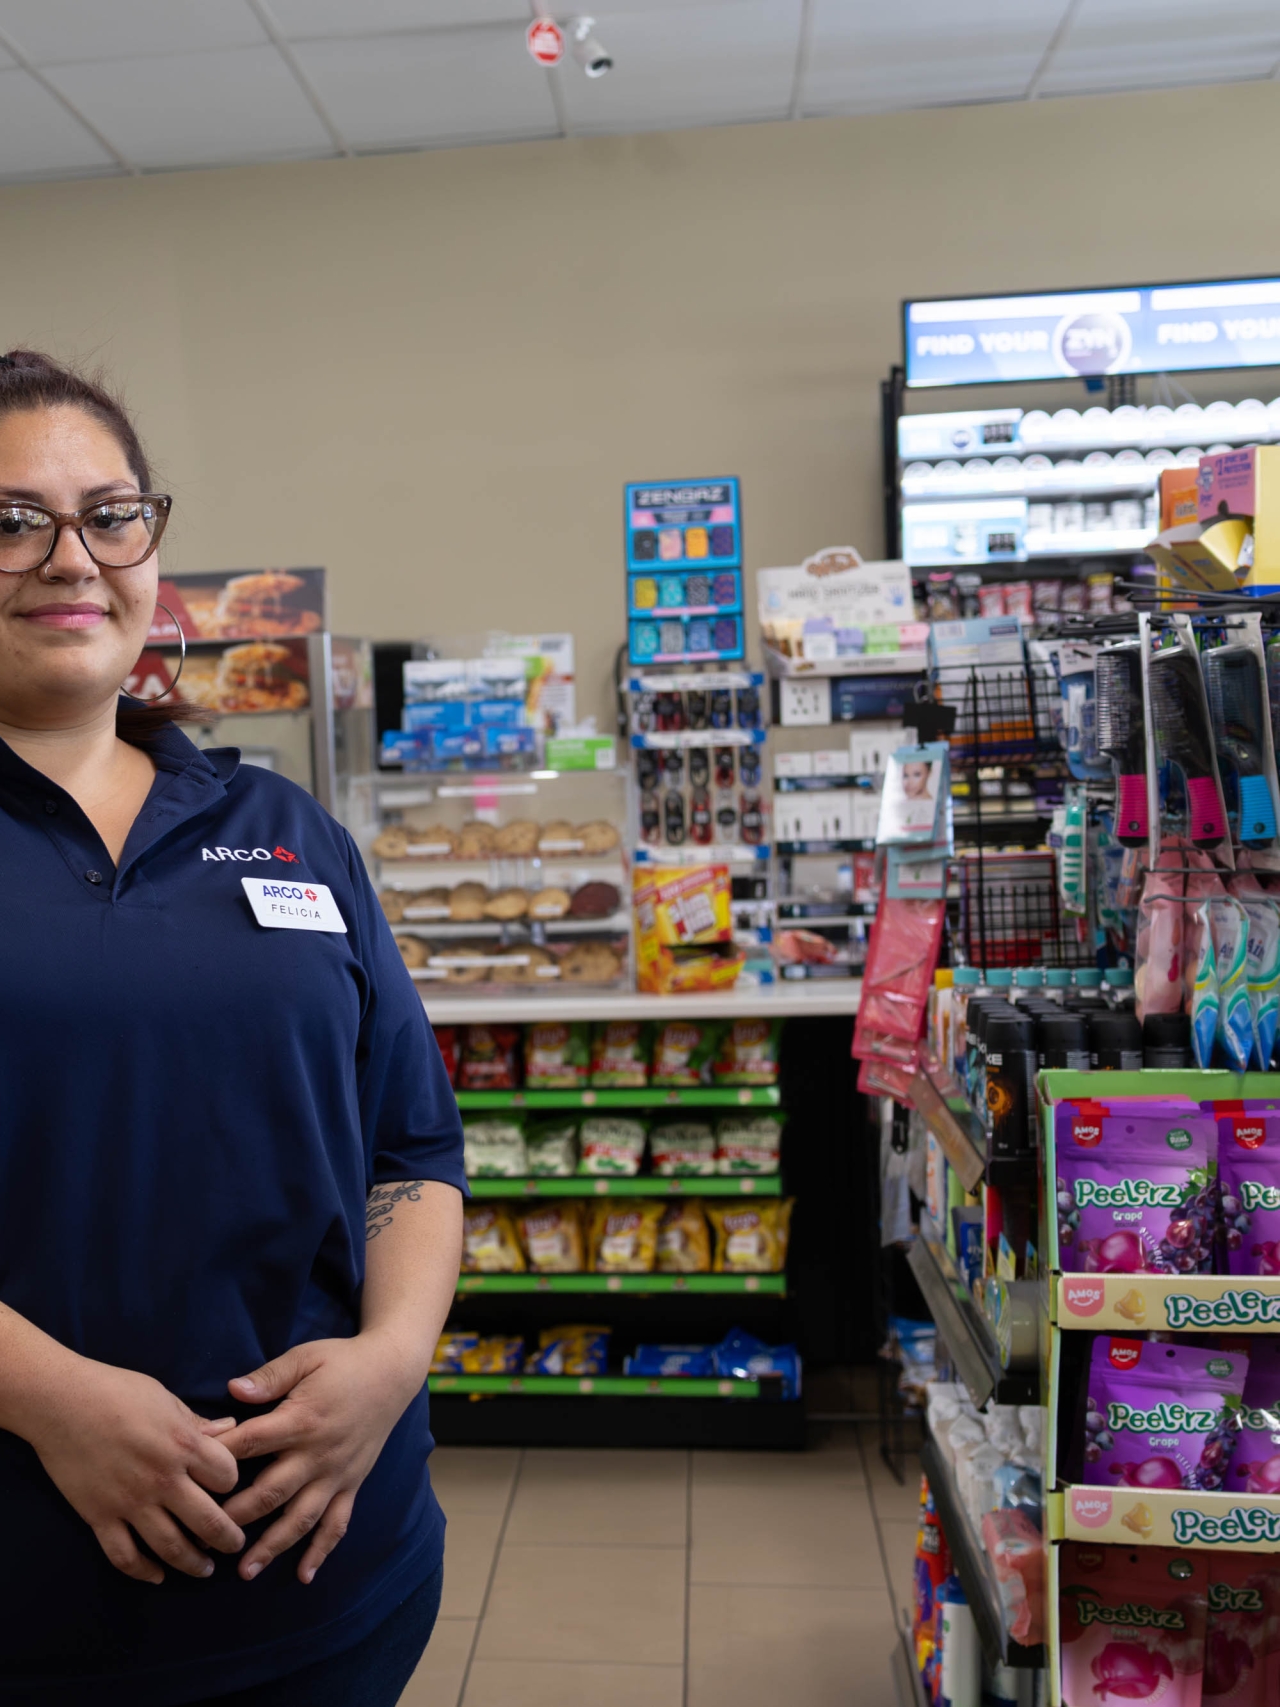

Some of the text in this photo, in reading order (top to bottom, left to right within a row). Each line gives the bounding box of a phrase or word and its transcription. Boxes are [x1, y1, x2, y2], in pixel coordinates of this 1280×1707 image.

[1157, 322, 1218, 345] FIND
[917, 334, 974, 356] FIND
[979, 330, 1049, 354] YOUR
[201, 847, 271, 862] ARCO
[263, 885, 303, 900] ARCO
[271, 904, 322, 920] FELICIA
[986, 1054, 1003, 1066] XE
[1074, 1125, 1100, 1136] AMOS
[1236, 1126, 1263, 1137] AMOS
[1074, 1177, 1184, 1209] Peelerz
[1067, 1288, 1101, 1301] AMOS
[1111, 1348, 1138, 1359] AMOS
[1106, 1402, 1217, 1434] Peelerz
[1148, 1436, 1180, 1447] Grape
[1075, 1500, 1280, 1545] AMOS Peeler
[1208, 1582, 1265, 1613] lerz
[1077, 1600, 1186, 1629] Peelerz
